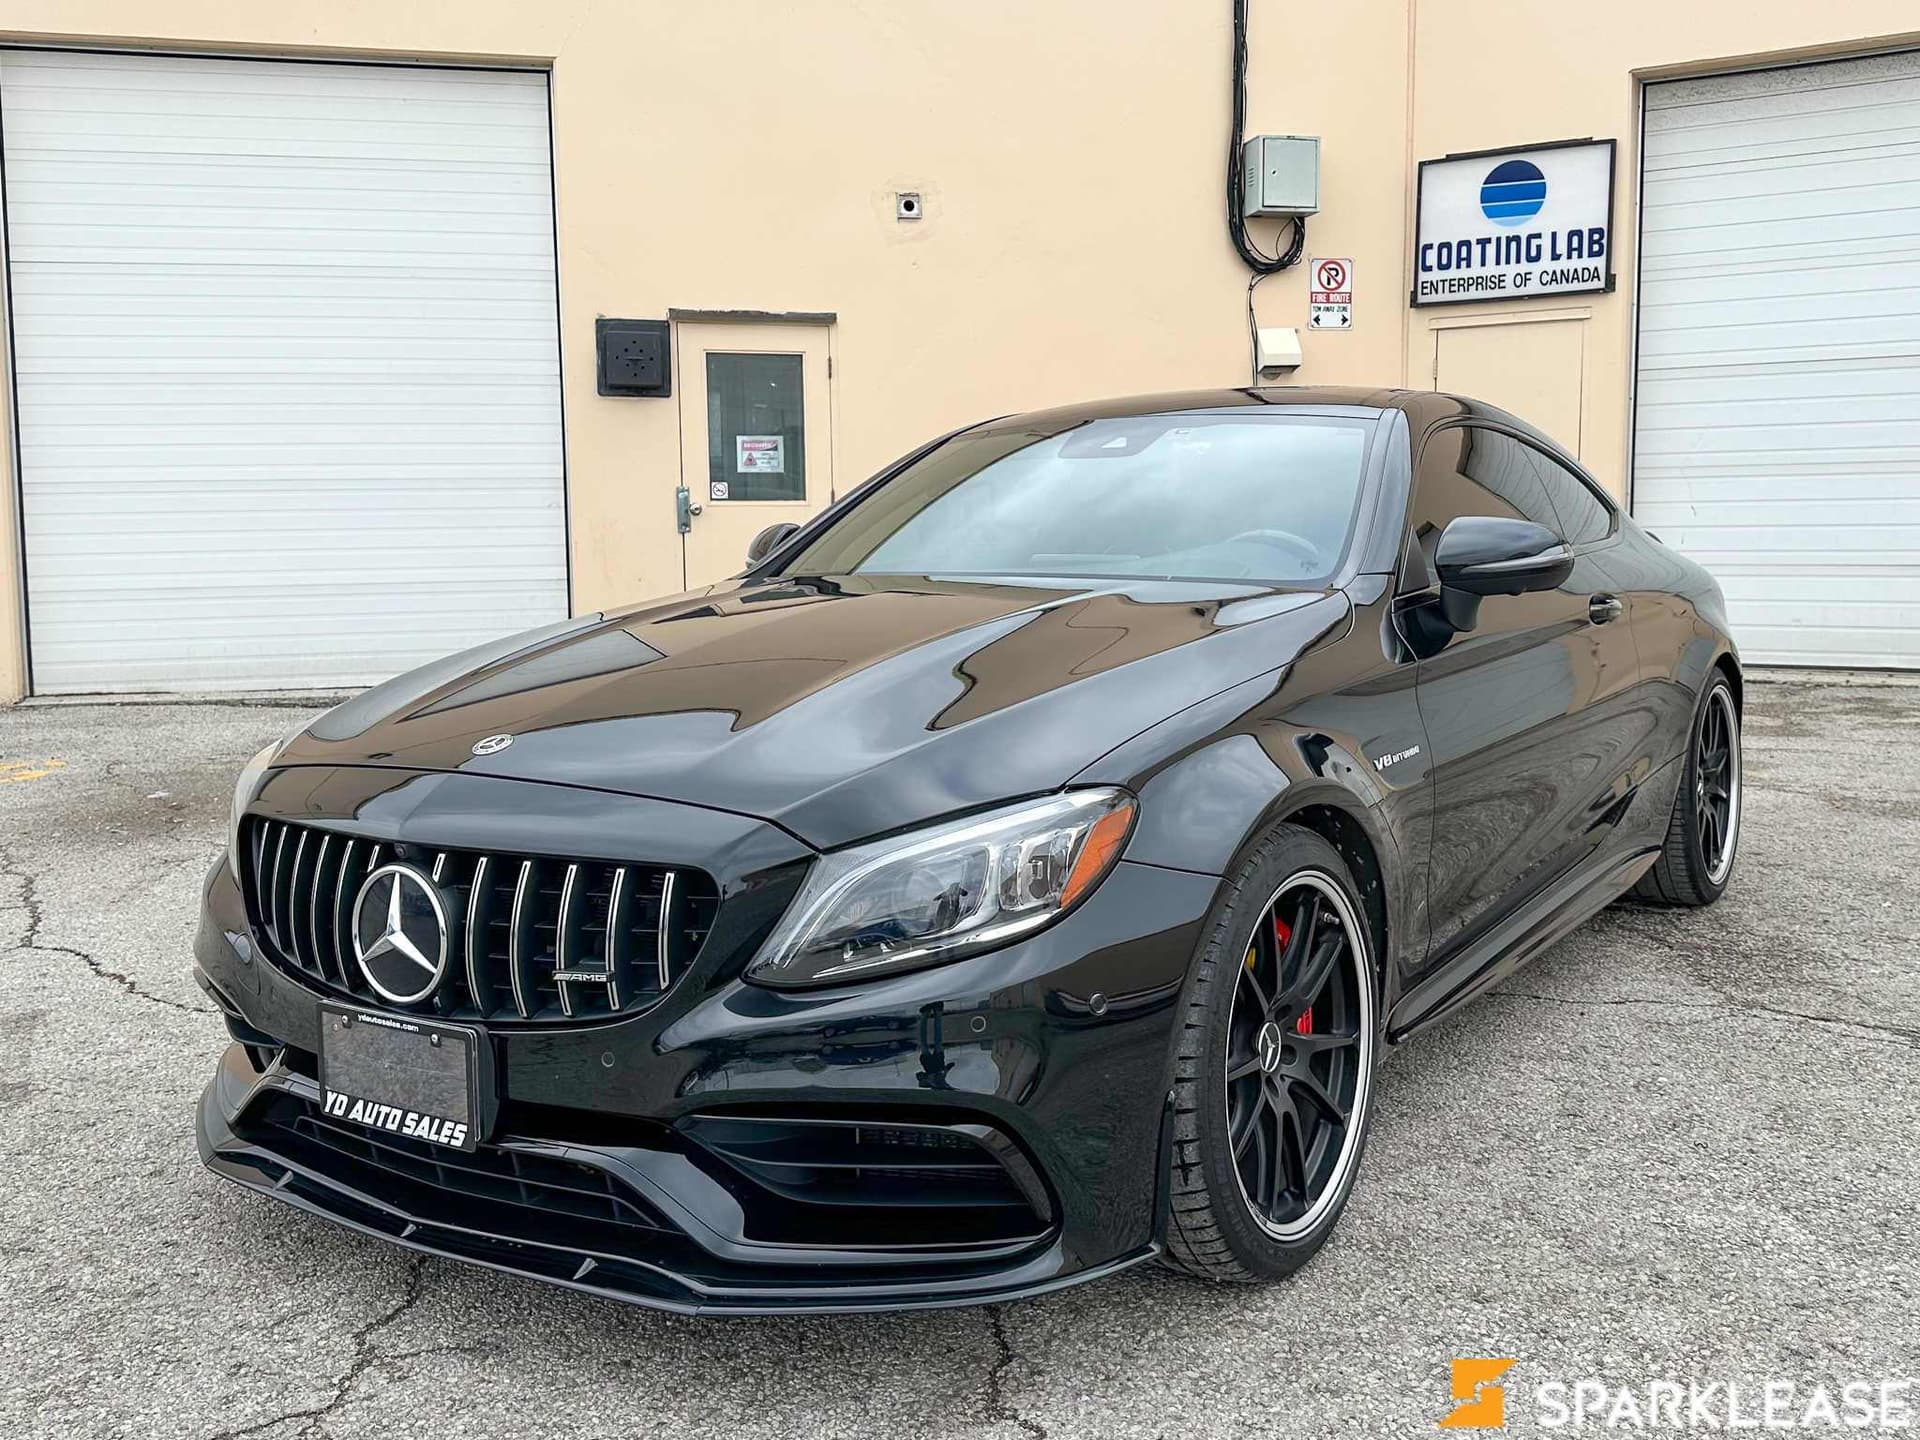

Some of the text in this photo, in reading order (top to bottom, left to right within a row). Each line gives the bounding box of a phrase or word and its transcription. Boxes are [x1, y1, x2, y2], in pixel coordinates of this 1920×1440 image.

[1421, 227, 1605, 272] COATING LAB
[1421, 266, 1600, 296] ENTERPRISE OF CANADA
[1312, 293, 1350, 303] FIRE ROUTE
[1373, 753, 1392, 771] V8
[570, 974, 607, 982] AMG
[348, 1099, 403, 1131] AUTO
[402, 1112, 468, 1147] SALES
